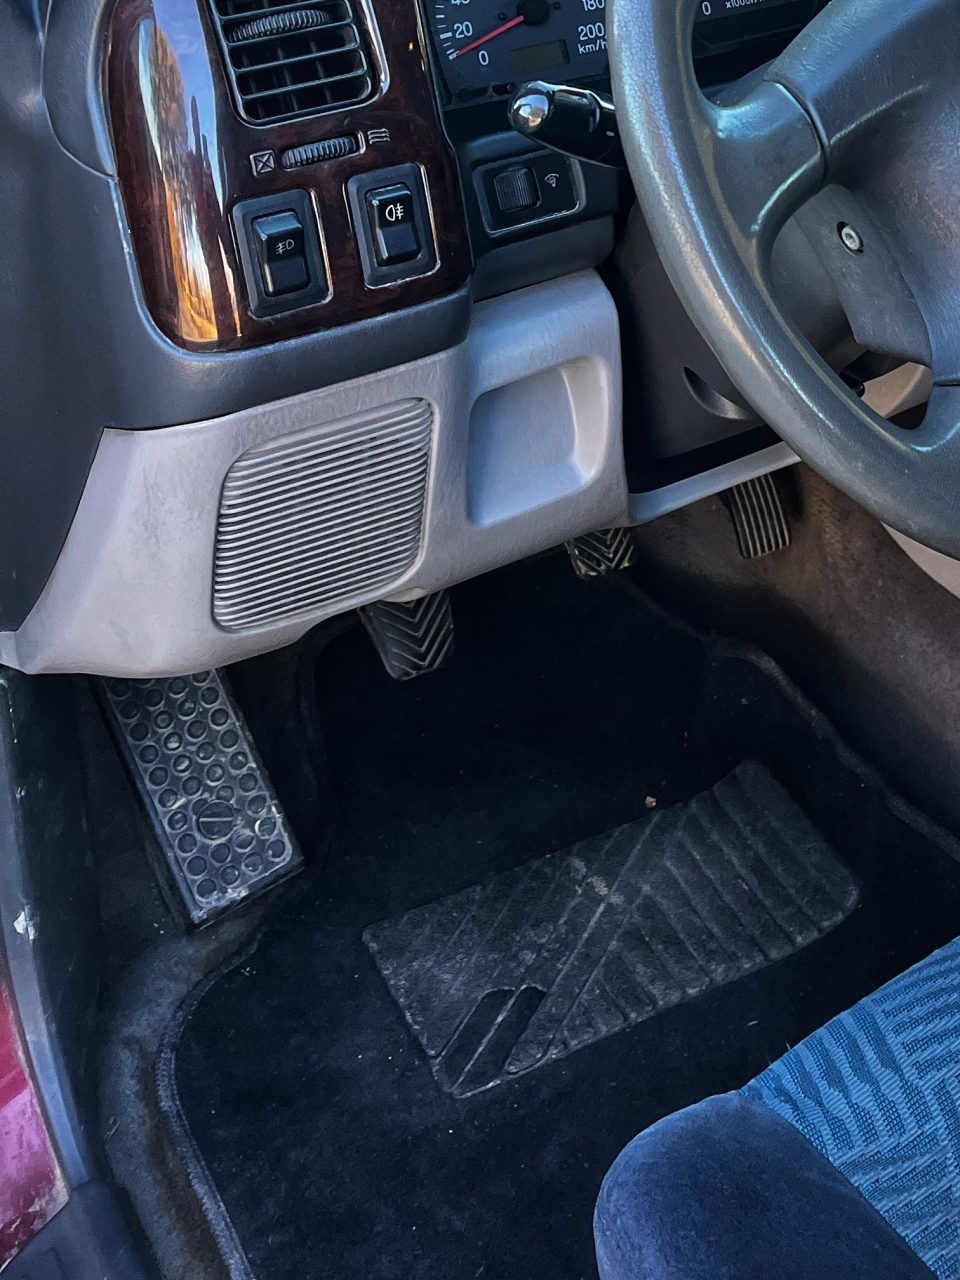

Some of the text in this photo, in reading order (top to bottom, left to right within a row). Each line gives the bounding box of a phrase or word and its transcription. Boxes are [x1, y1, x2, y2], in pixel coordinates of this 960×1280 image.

[702, 1, 712, 15] 0
[454, 21, 473, 38] 20
[578, 23, 605, 41] 200
[478, 50, 489, 66] 0
